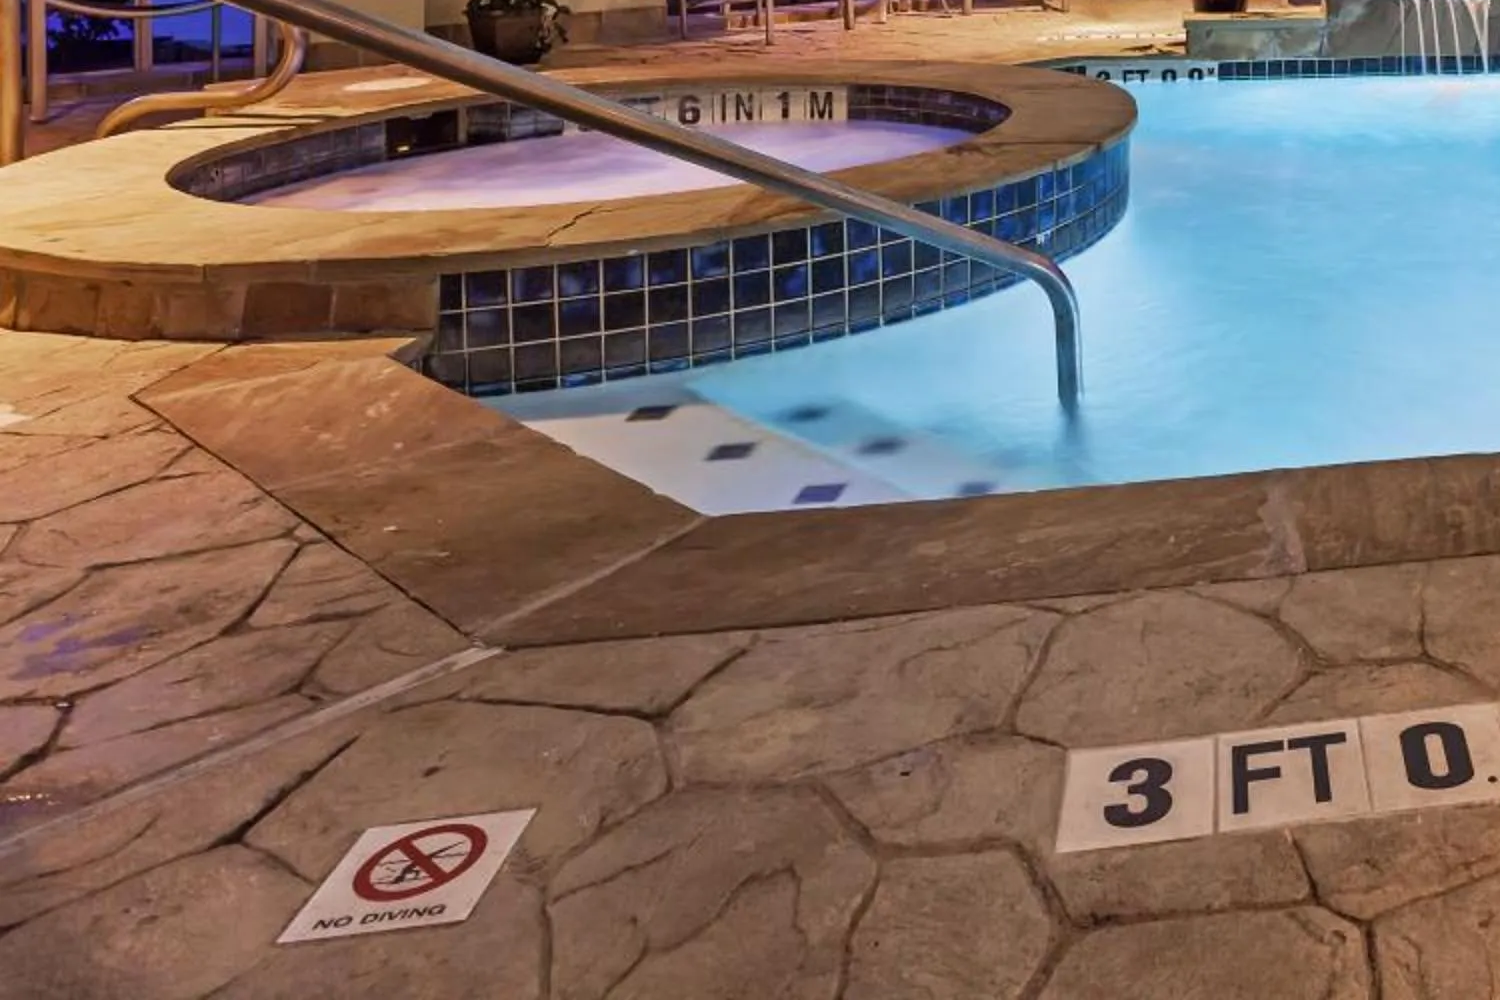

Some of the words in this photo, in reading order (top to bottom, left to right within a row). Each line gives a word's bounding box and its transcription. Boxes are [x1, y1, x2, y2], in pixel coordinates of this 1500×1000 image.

[677, 94, 700, 125] 6
[721, 93, 753, 121] IN
[776, 91, 789, 120] 1
[810, 91, 833, 120] M
[1102, 757, 1173, 828] 3
[1231, 731, 1347, 814] FT
[312, 915, 351, 931] NO
[359, 903, 448, 926] DIVING
